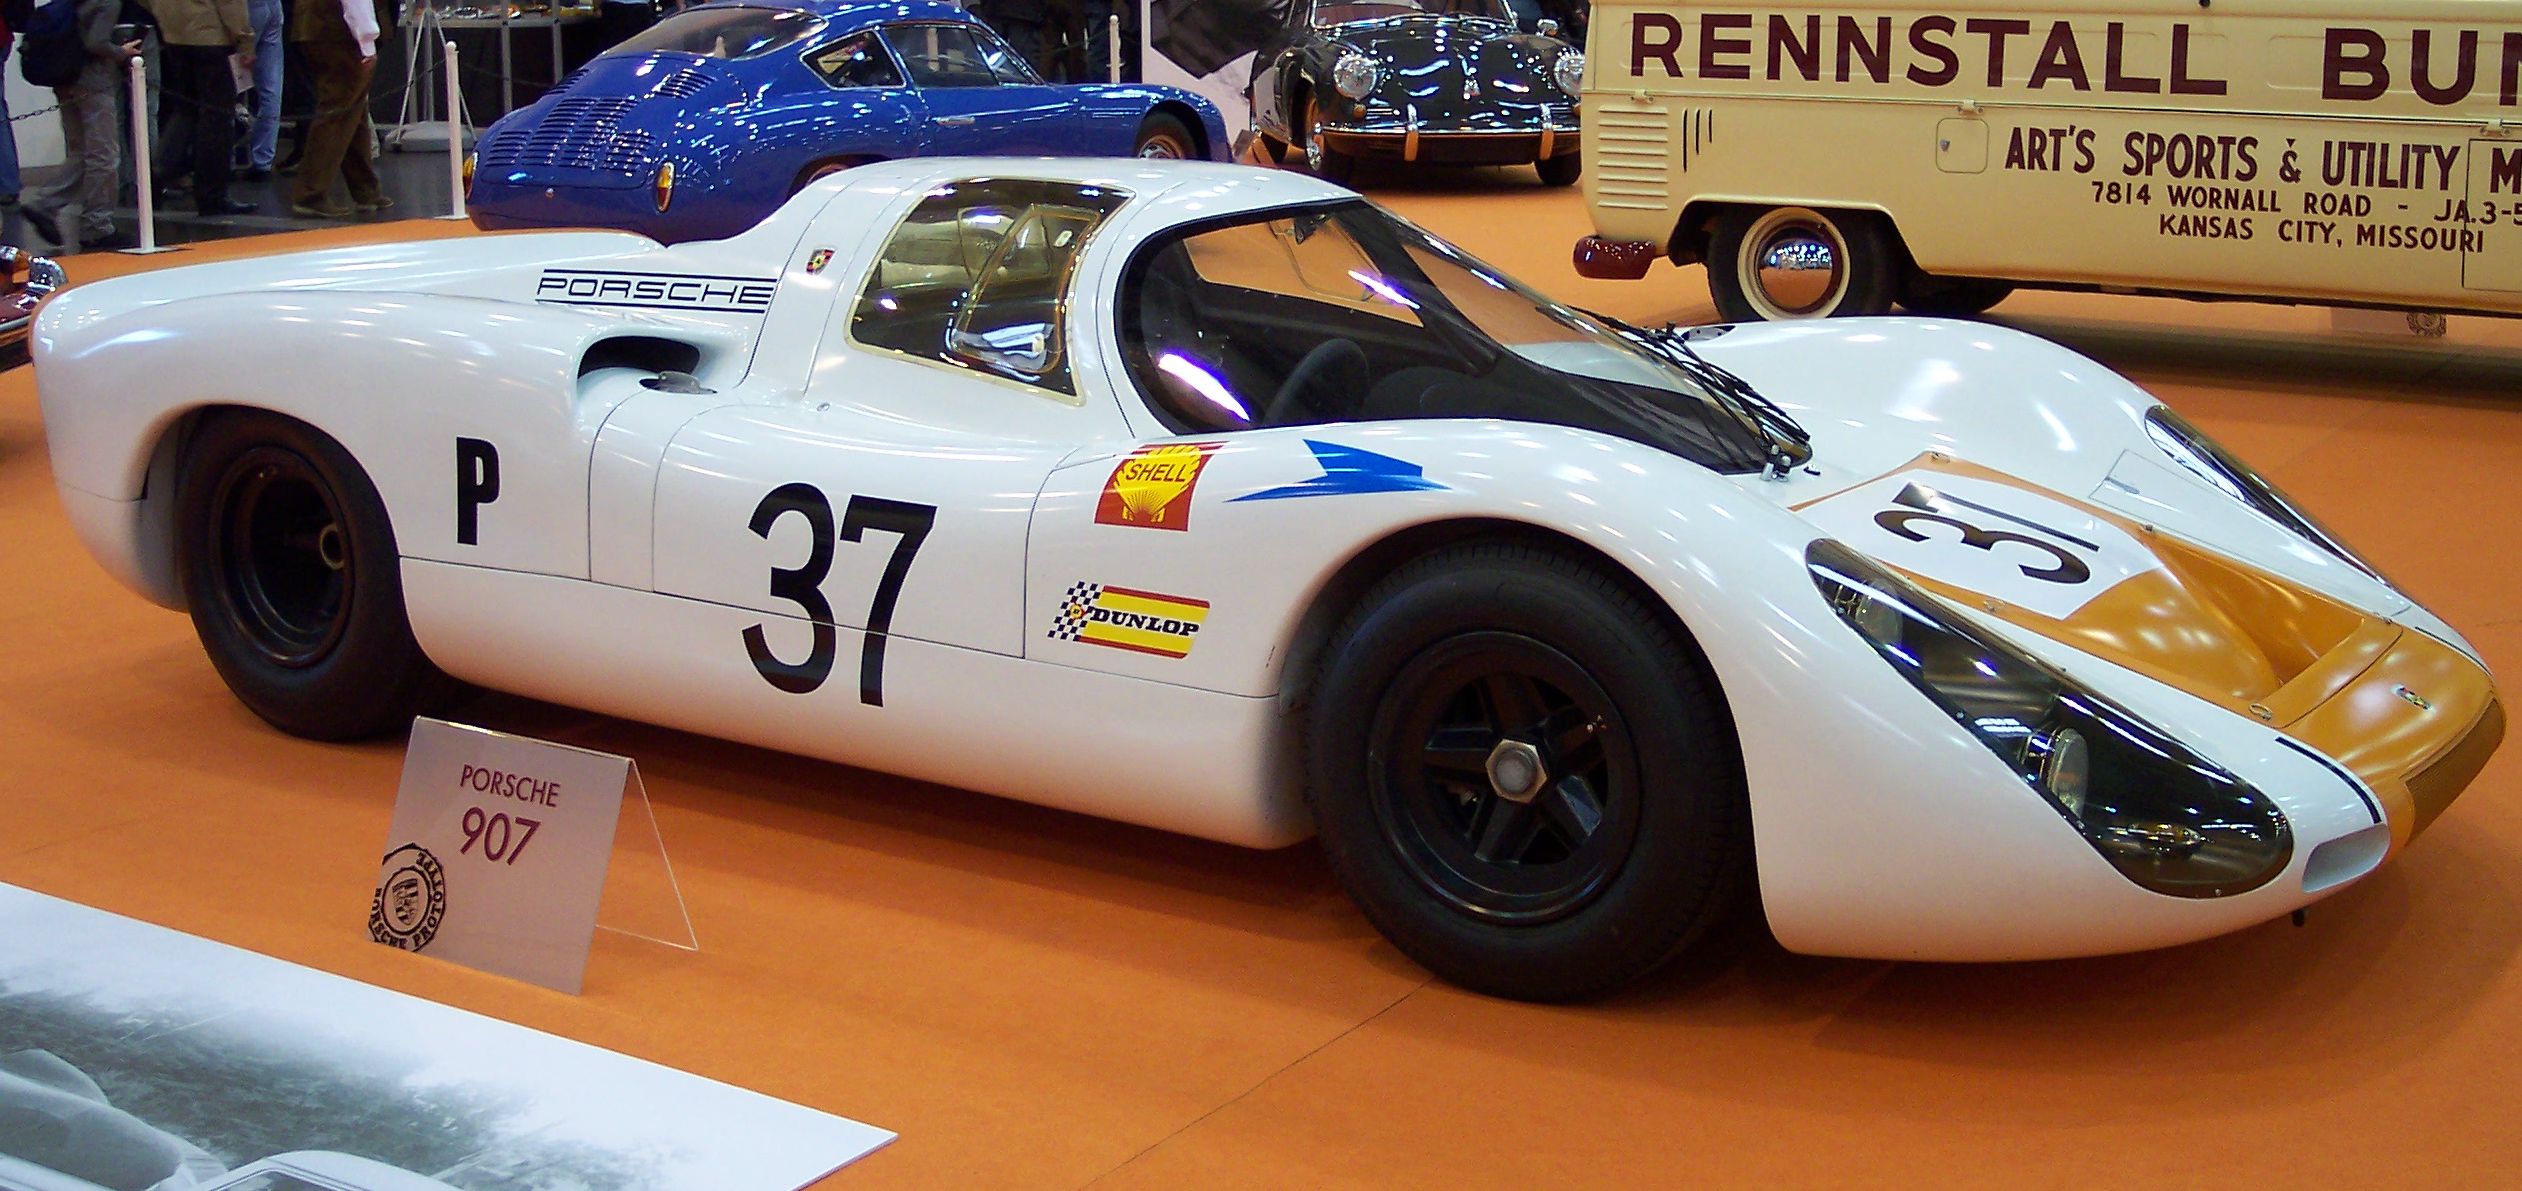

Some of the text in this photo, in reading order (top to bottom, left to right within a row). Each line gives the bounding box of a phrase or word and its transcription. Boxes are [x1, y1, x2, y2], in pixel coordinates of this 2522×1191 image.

[1631, 13, 2227, 95] RENNSTALL
[2005, 125, 2096, 173] ART'S
[2122, 131, 2258, 182] SPORTS
[2279, 150, 2301, 183] &
[2321, 140, 2461, 191] UTILITY
[2091, 181, 2151, 205] 7814
[2167, 184, 2281, 213] WORNALL
[2304, 192, 2371, 217] ROAD
[2160, 213, 2483, 253] KANSAS CITY, MISSOURI
[537, 277, 775, 305] PORSCHE
[456, 436, 500, 546] P
[1124, 462, 1187, 483] SHELL
[1874, 482, 2100, 584] 37
[742, 482, 937, 708] 37
[1087, 606, 1199, 636] DUNLOP
[459, 764, 561, 808] PORSCHE
[459, 807, 541, 866] 907
